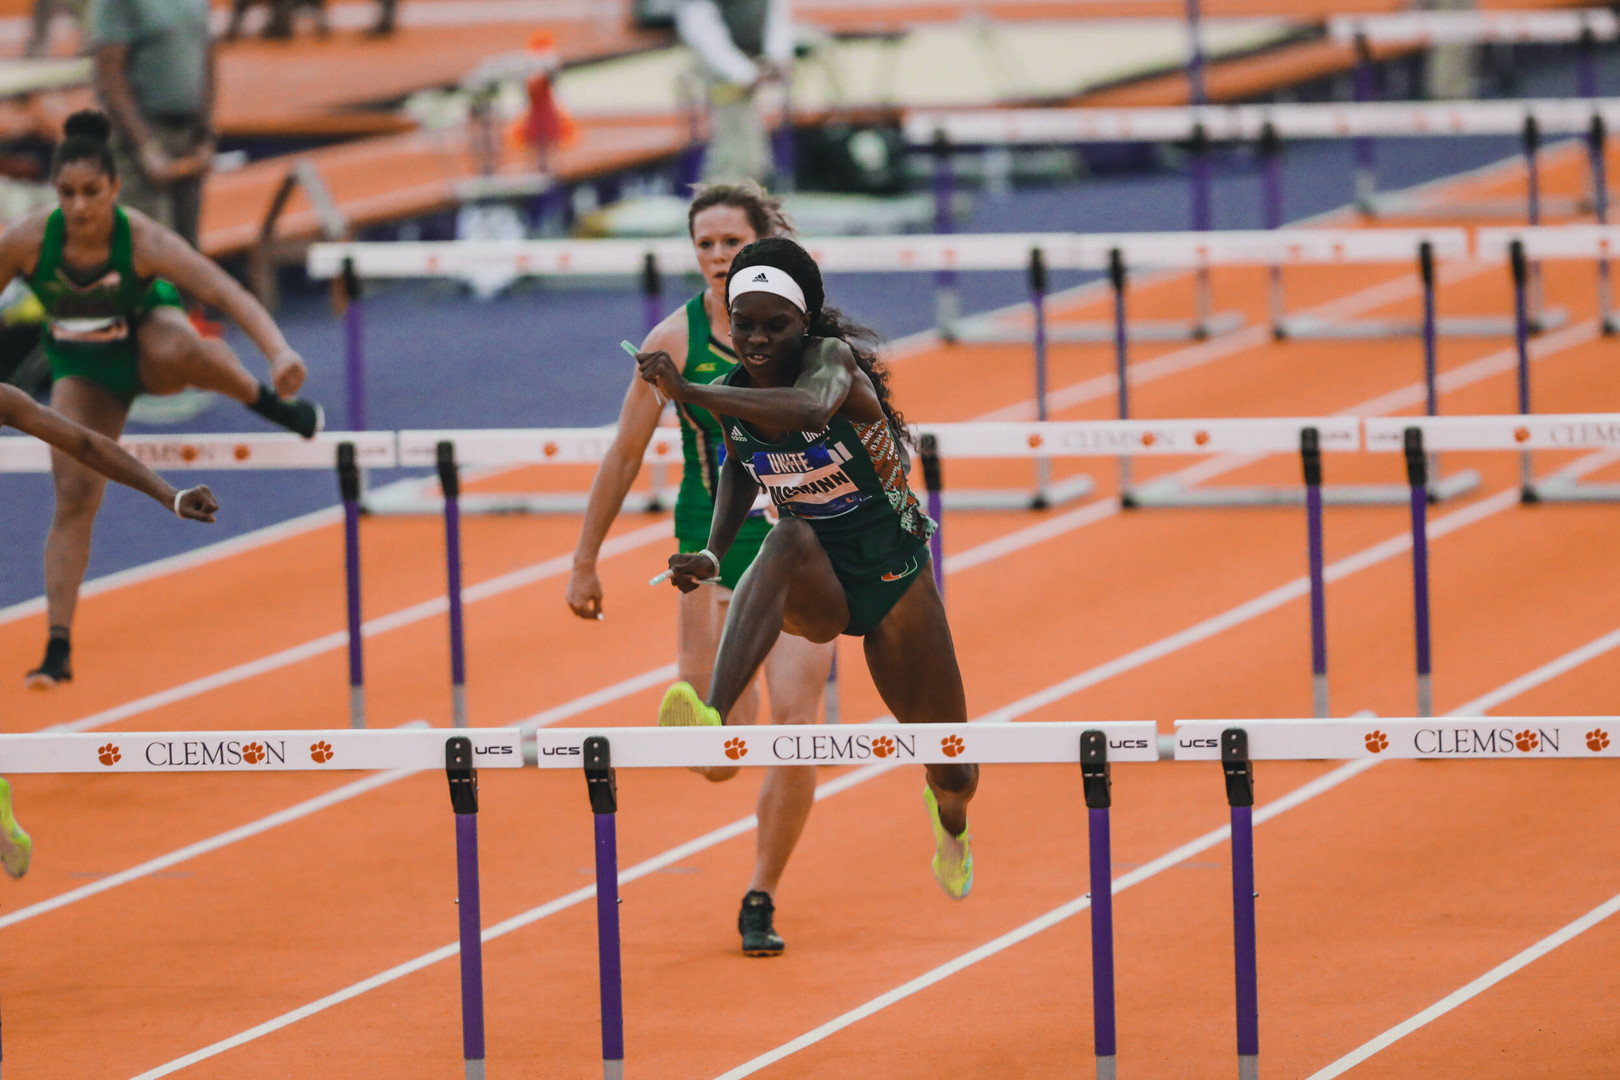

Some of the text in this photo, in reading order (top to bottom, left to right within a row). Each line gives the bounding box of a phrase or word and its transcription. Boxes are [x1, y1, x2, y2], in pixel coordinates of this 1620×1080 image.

[766, 452, 814, 474] UNITE
[772, 733, 916, 762] CLEMSON
[1109, 738, 1149, 750] UCS
[1179, 738, 1218, 748] UCS
[1414, 728, 1560, 754] CLEMSON
[145, 740, 286, 767] CLEMSON
[475, 744, 513, 756] UCS
[542, 745, 581, 757] UCS
